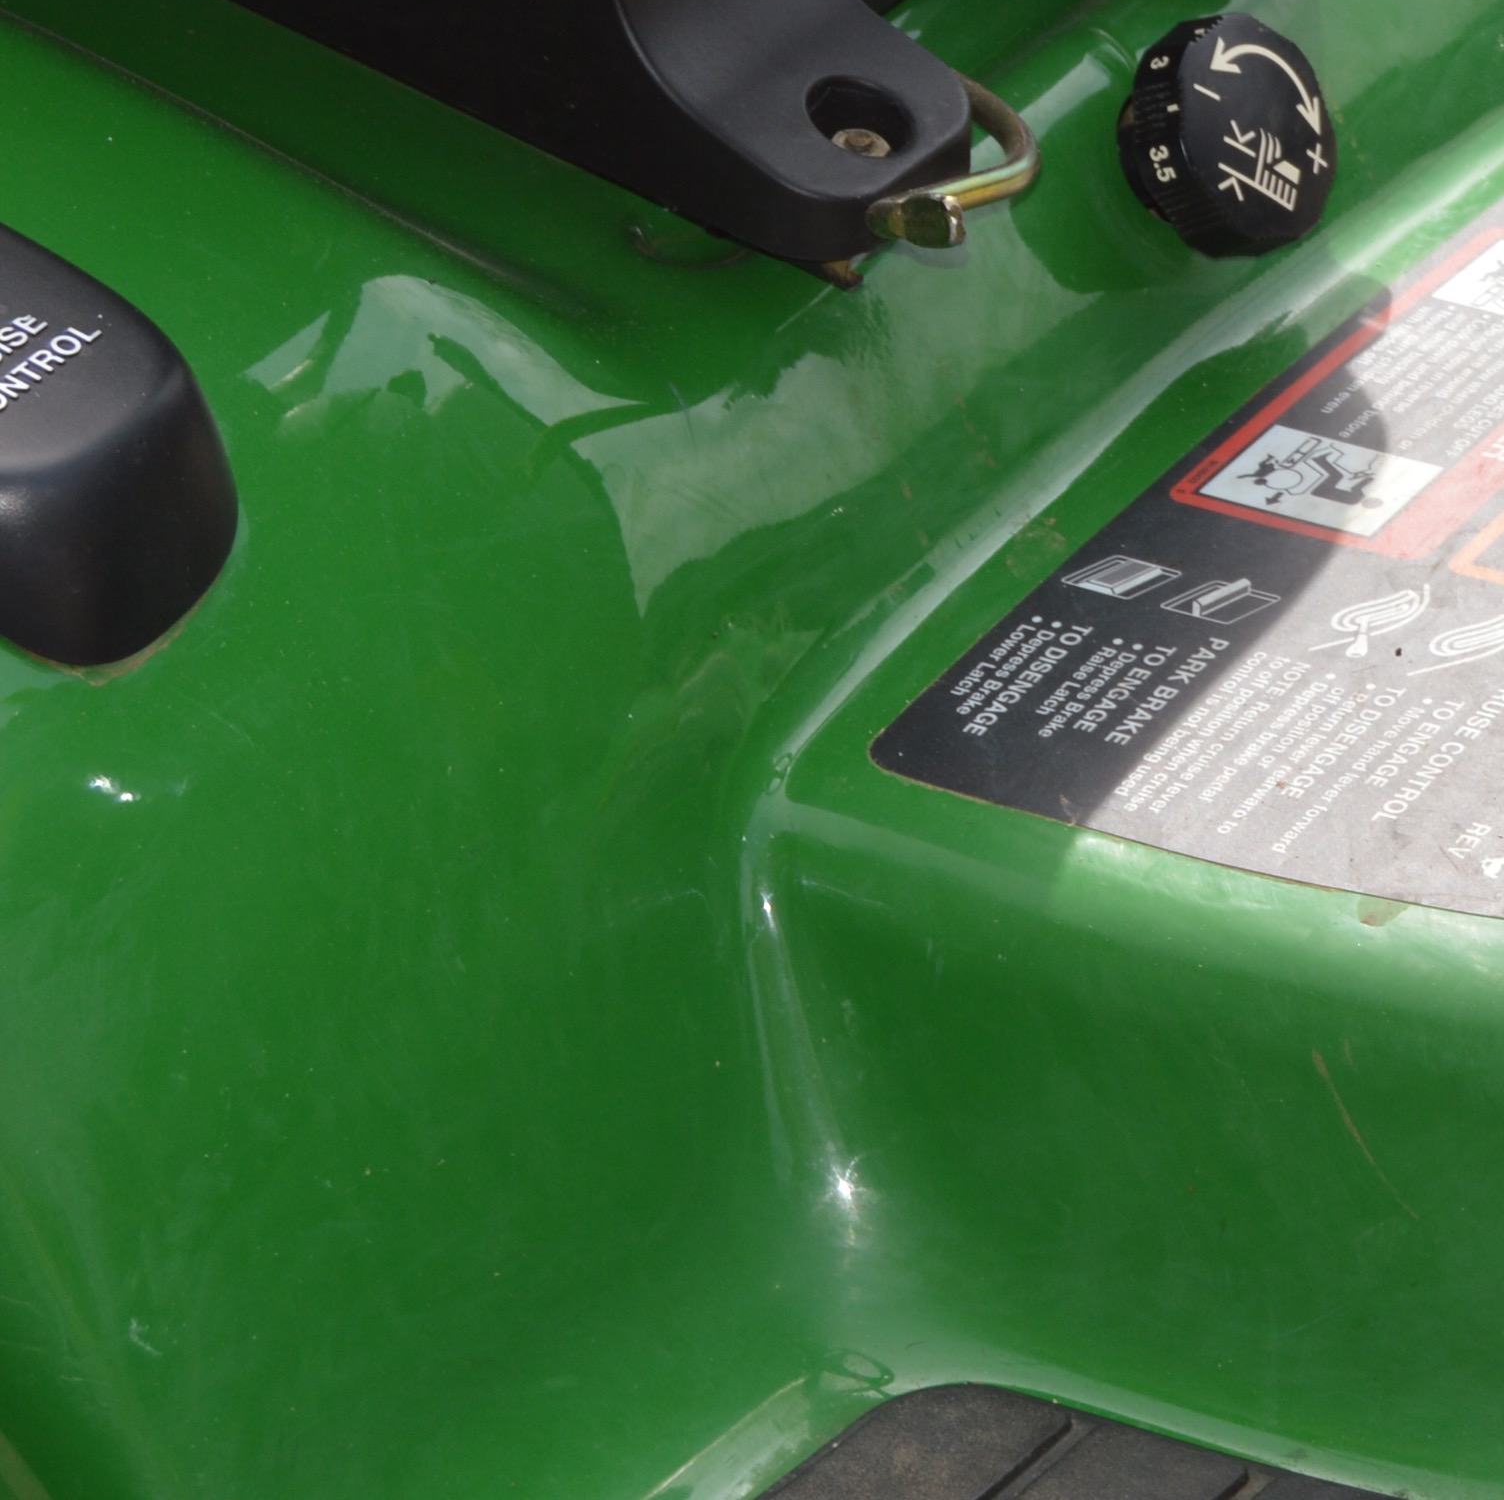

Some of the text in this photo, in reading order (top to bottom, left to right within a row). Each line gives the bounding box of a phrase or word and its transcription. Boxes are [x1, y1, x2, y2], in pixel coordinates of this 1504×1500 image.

[1150, 55, 1170, 70] 3
[1149, 145, 1177, 182] 3.5
[0, 314, 48, 362] ISE
[0, 326, 102, 412] NTROL
[1445, 438, 1471, 458] OFF
[1452, 403, 1488, 429] LEGS
[1465, 419, 1493, 439] CUT
[949, 623, 1037, 696] Lower Latch
[955, 629, 1056, 716] Depress Brake
[962, 625, 1094, 737] TO DISENGAGE
[1034, 646, 1118, 716] Raise Latch
[1037, 651, 1137, 738] Depress Brake
[1072, 645, 1178, 733] TO ENGAGE
[1104, 636, 1230, 746] PARK BRAKE
[1113, 650, 1268, 797] control is not being used
[1123, 656, 1292, 812] to off position when cruise
[1148, 661, 1312, 815] NOTE: Return cruise lever
[1198, 681, 1329, 804] Depress brake pedal
[1257, 686, 1345, 770] off position or
[1279, 687, 1408, 799] TO DISENGAGE
[1288, 733, 1327, 764] lever
[1318, 693, 1370, 732] Return
[1364, 700, 1466, 788] TO ENGAGE
[1270, 706, 1426, 854] Move hand lever forward
[1370, 741, 1466, 822] CONTROL
[1216, 820, 1239, 834] to
[1446, 822, 1493, 860] REV
